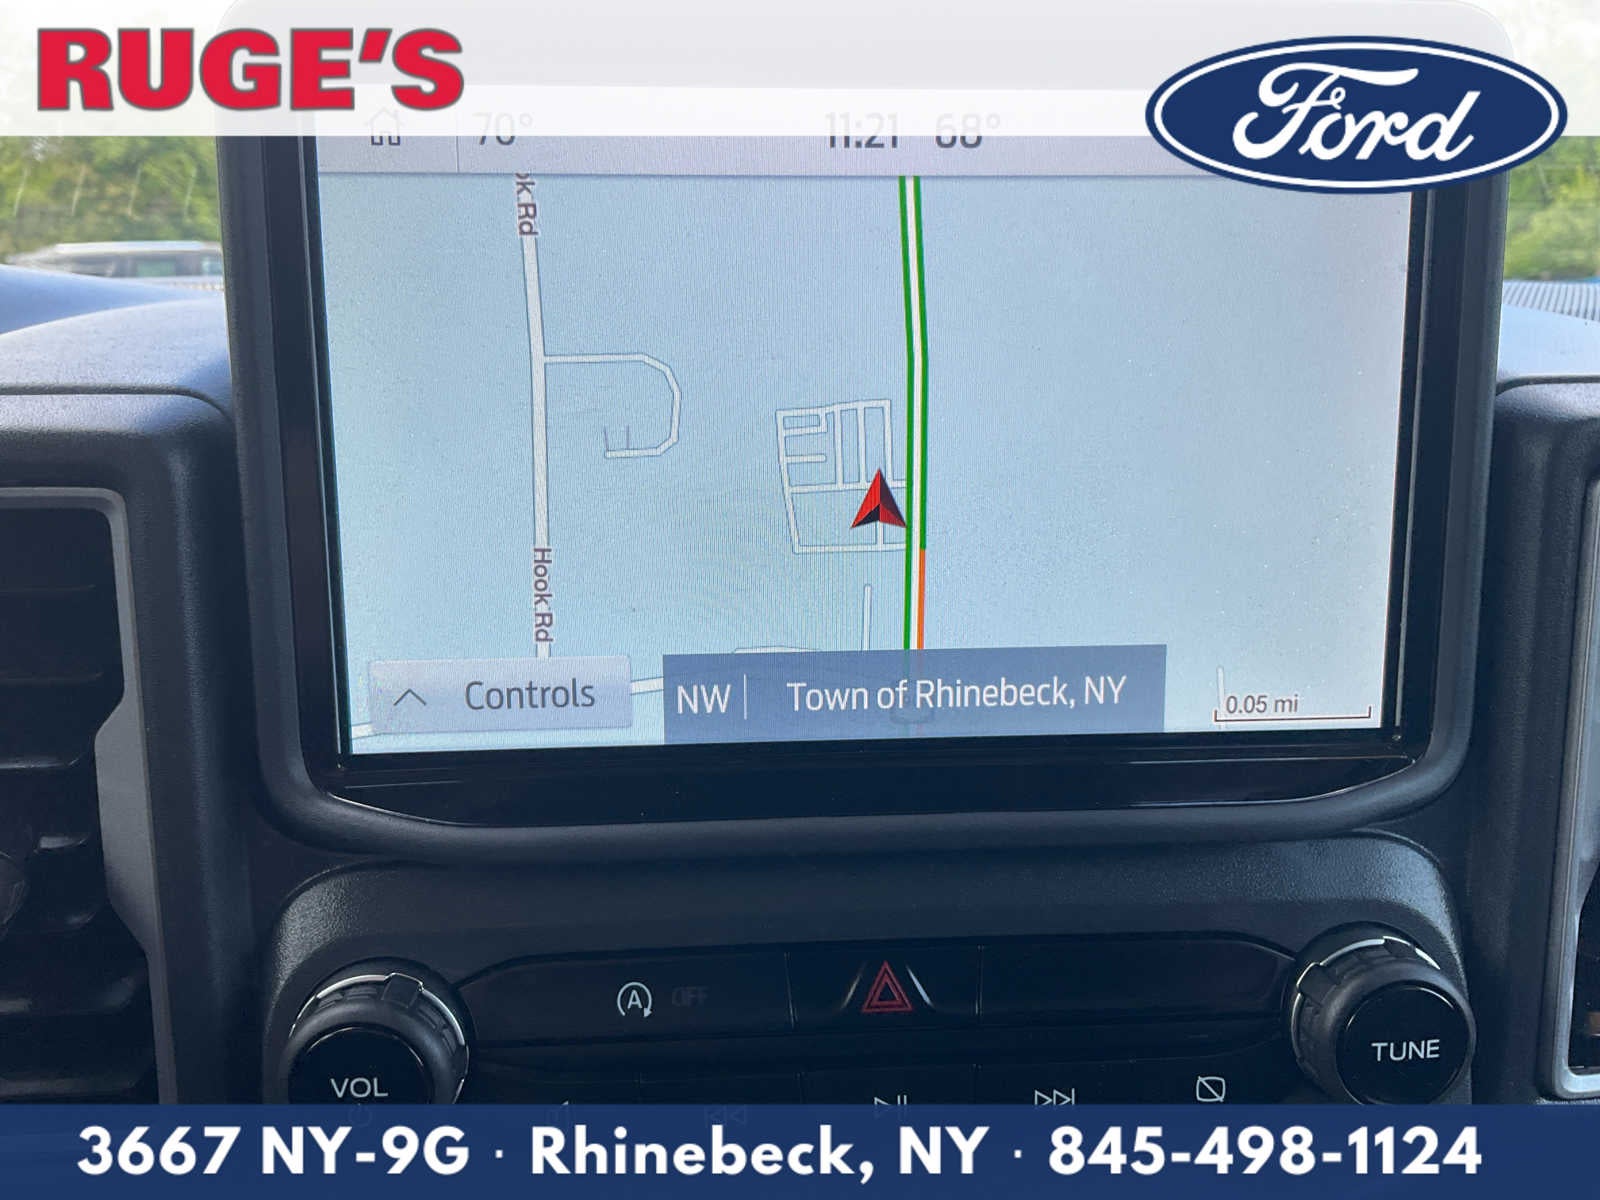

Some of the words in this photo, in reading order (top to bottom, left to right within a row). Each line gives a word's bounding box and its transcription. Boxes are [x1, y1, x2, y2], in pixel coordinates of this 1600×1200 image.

[825, 111, 898, 149] 11:21
[517, 203, 538, 236] Rd
[533, 548, 553, 605] Hook
[534, 612, 554, 642] Rd
[465, 678, 595, 710] Controls
[677, 683, 731, 714] NW
[787, 681, 868, 711] Town
[876, 679, 908, 709] of
[916, 676, 1076, 709] Rhinebeck,
[1084, 675, 1127, 705] NY
[1225, 695, 1268, 714] 0.05
[1273, 694, 1299, 712] mi
[1371, 1038, 1440, 1062] TUNE
[330, 1077, 389, 1098] VOL
